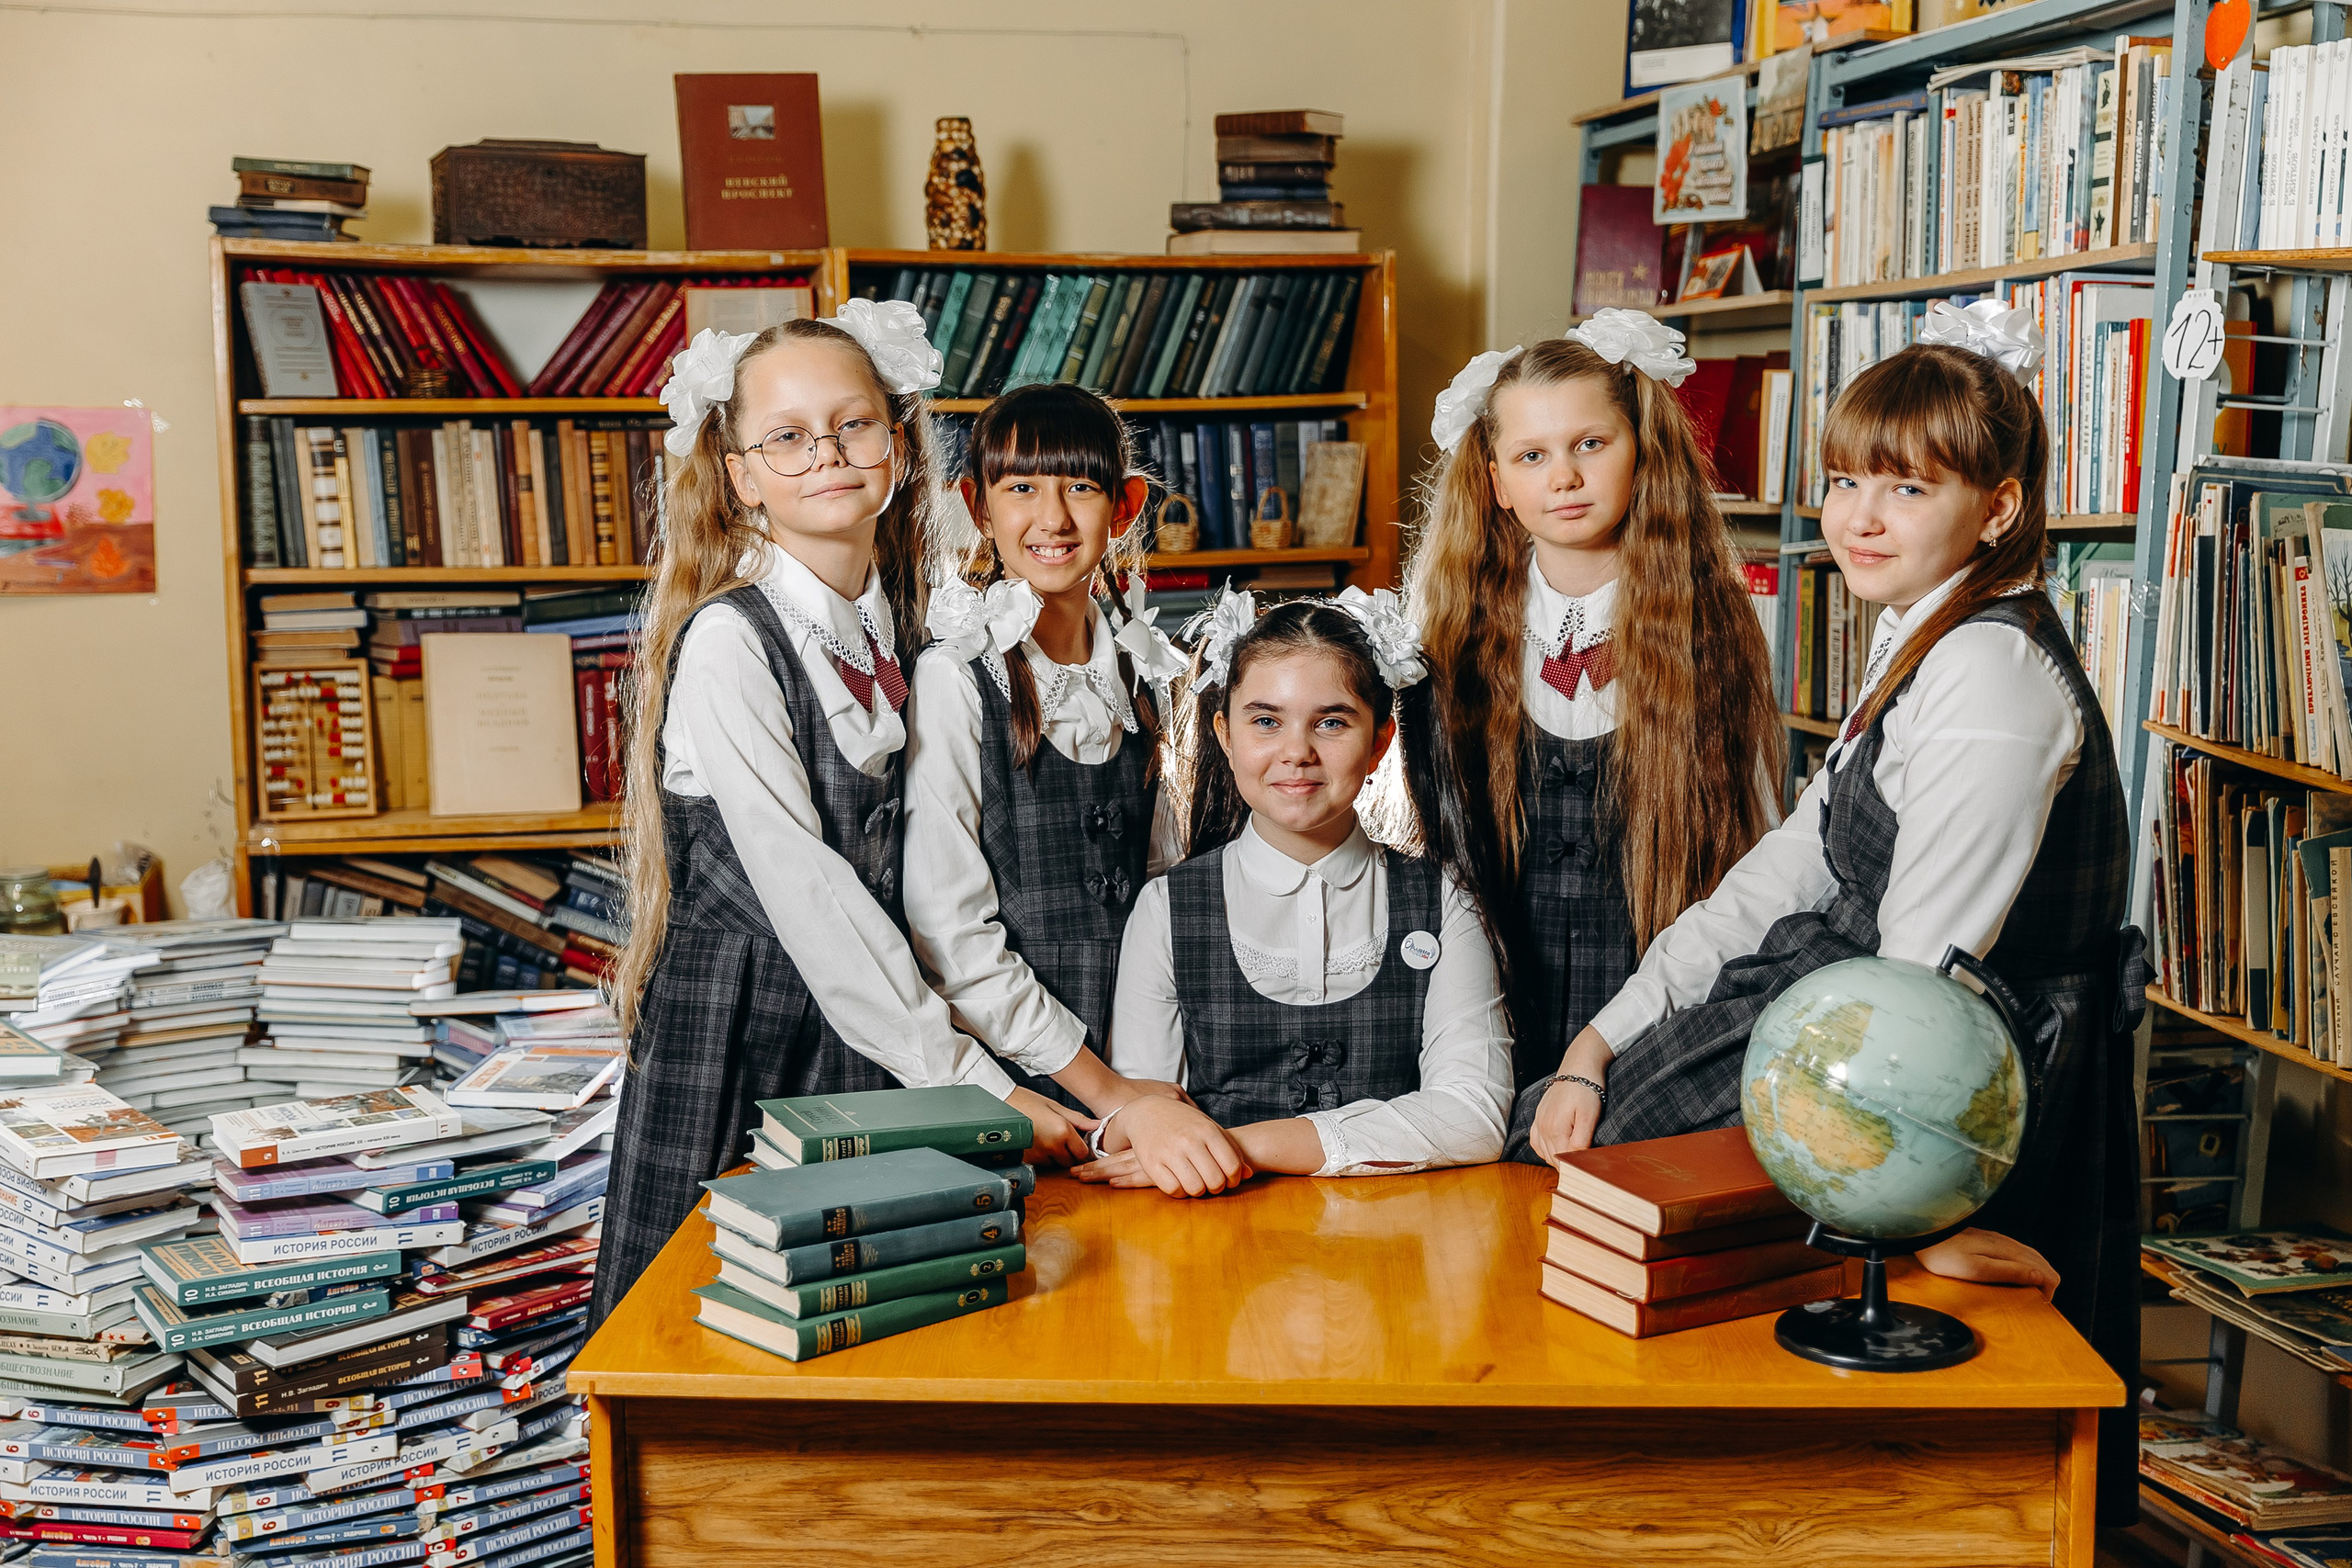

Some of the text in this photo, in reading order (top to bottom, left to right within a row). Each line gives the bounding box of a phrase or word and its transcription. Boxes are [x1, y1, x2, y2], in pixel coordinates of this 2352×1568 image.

[2135, 119, 2143, 184] ФАНТАЗЁРЫ
[725, 174, 788, 187] НЕВСКИЙ
[2171, 310, 2223, 369] 12+
[2301, 585, 2313, 714] ПРИКЛЮЧЕНИЯ ЭЛЕКТРОНИКА
[17, 1174, 48, 1196] ИСТОРИЯ
[406, 1179, 495, 1203] ВСЕОБЩАЯ ИСТОРИЯ
[24, 1200, 33, 1213] 10
[389, 1196, 401, 1209] 10
[978, 1195, 990, 1205] 5
[588, 1203, 599, 1220] 11
[37, 1223, 48, 1235] 11
[983, 1229, 998, 1238] 4
[274, 1236, 378, 1255] ИСТОРИЯ РОССИИ
[398, 1233, 413, 1246] 11
[470, 1222, 548, 1254] ИСТОРИЯ РОССИИ
[26, 1242, 37, 1257] 11
[28, 1262, 39, 1277] 11
[254, 1265, 368, 1290] ВСЕОБЩАЯ ИСТОРИЯ
[185, 1289, 198, 1303] 10
[327, 1283, 359, 1297] Алгебра
[37, 1293, 49, 1307] 11
[241, 1304, 356, 1332] ВСЕОБЩАЯ ИСТОРИЯ
[171, 1334, 185, 1348] 10
[338, 1337, 412, 1361] ВСЕОБЩАЯ ИСТОРИЯ
[254, 1369, 268, 1385] 11
[338, 1360, 412, 1385] ВСЕОБЩАЯ ИСТОРИЯ
[298, 1382, 329, 1394] Загладин
[403, 1385, 451, 1404] ИСТОРИЯ
[538, 1382, 567, 1400] РОССИИ
[255, 1393, 268, 1409] 11
[447, 1396, 489, 1416] РОССИИ
[57, 1411, 141, 1429] ИСТОРИЯ РОССИИ
[217, 1426, 321, 1451] ИСТОРИЯ РОССИИ
[456, 1437, 470, 1450] 11
[42, 1446, 134, 1464] ИСТОРИЯ РОССИИ
[333, 1448, 347, 1462] 11
[206, 1455, 312, 1481] ИСТОРИЯ РОССИИ
[340, 1446, 438, 1481] ИСТОРИЯ РОССИИ
[30, 1484, 127, 1499] ИСТОРИЯ РОССИИ
[485, 1475, 554, 1497] ИСТОРИЯ РОССИИ
[147, 1490, 162, 1503] 11
[256, 1495, 271, 1506] 6
[456, 1495, 469, 1504] 7
[301, 1505, 354, 1524] ИСТОРИЯ
[356, 1494, 401, 1514] РОССИИ
[489, 1492, 570, 1525] ИСТОРИЯ РОССИИ
[71, 1510, 161, 1527] ИСТОРИЯ РОССИИ
[262, 1521, 277, 1531] 6
[461, 1521, 473, 1530] 6
[41, 1530, 74, 1540] Алгебра
[269, 1535, 307, 1547] Алгебра
[485, 1516, 571, 1552] ИСТОРИЯ РОССИИ
[366, 1543, 421, 1565] РОССИИ
[428, 1542, 447, 1553] 6
[498, 1536, 581, 1568] ИСТОРИЯ РОССИИ
